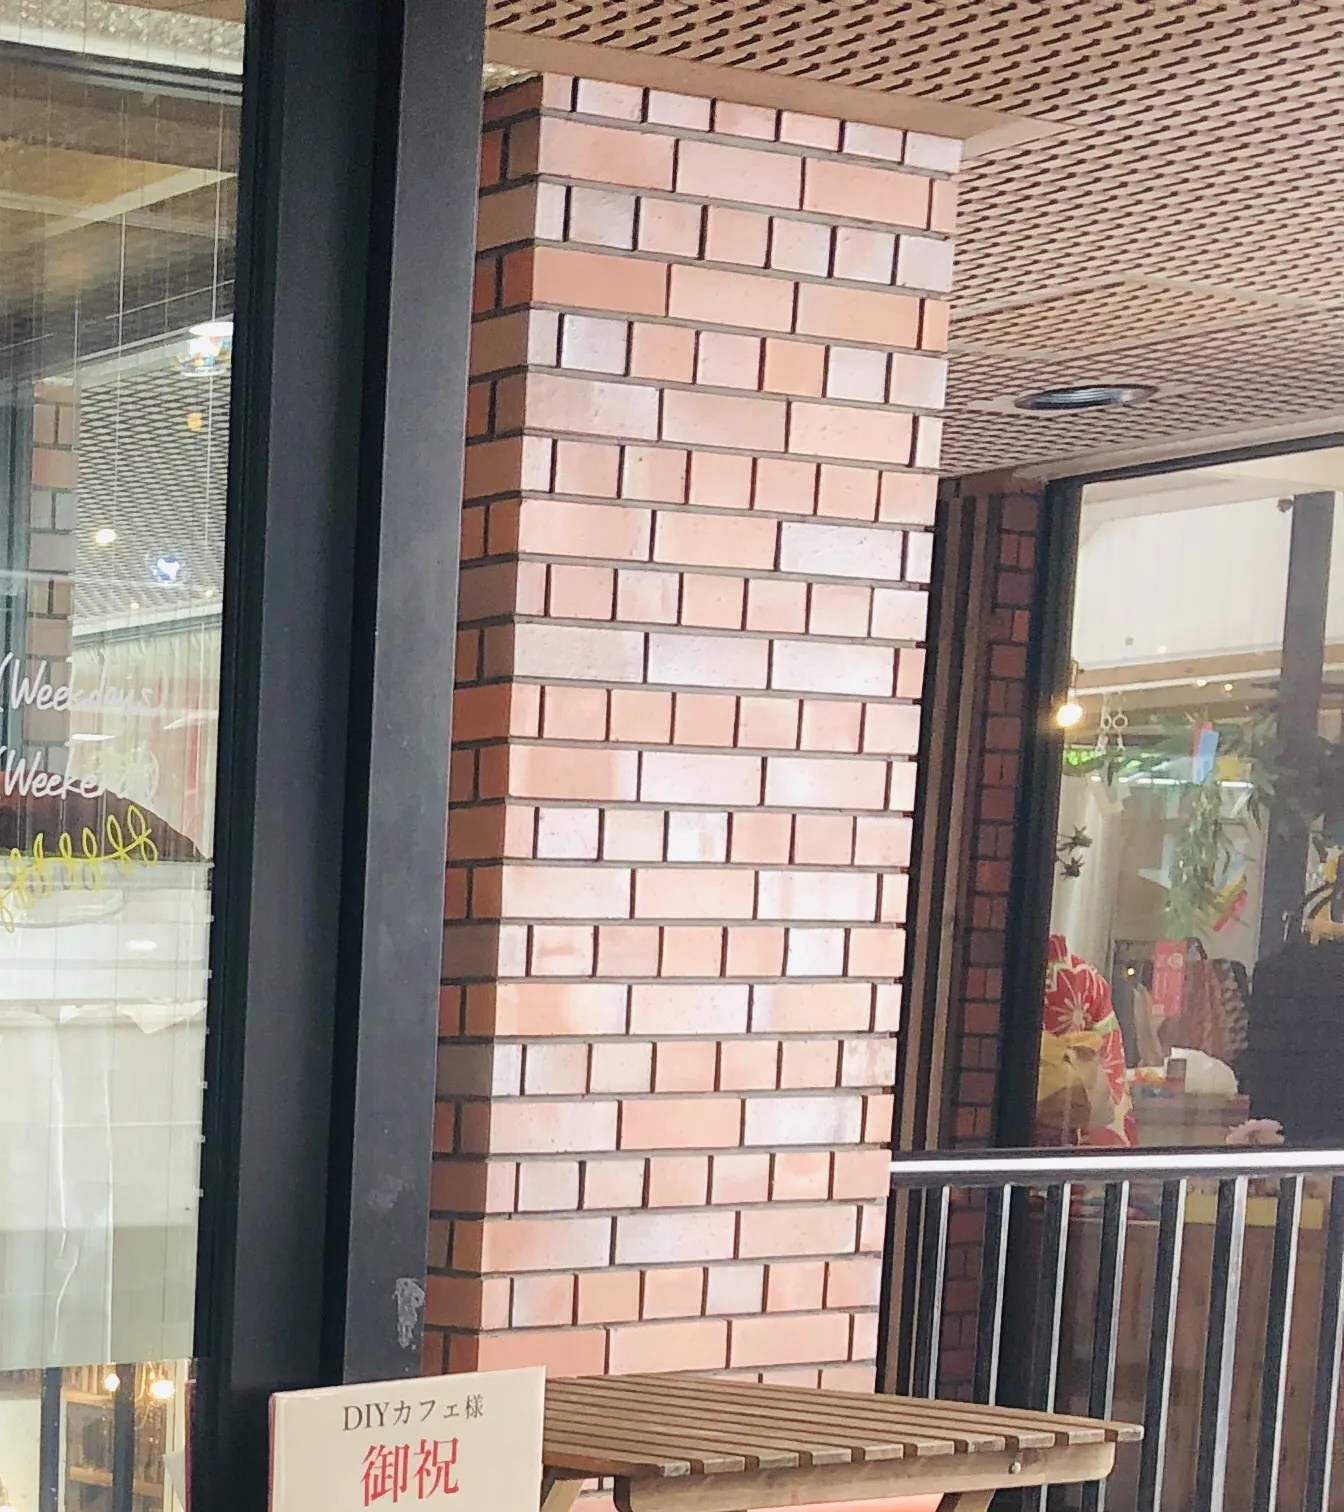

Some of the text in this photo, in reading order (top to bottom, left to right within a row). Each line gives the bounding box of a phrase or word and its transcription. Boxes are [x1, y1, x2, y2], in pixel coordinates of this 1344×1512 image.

[343, 1394, 484, 1432] DIYカフェ様
[360, 1437, 460, 1507] 御祝
